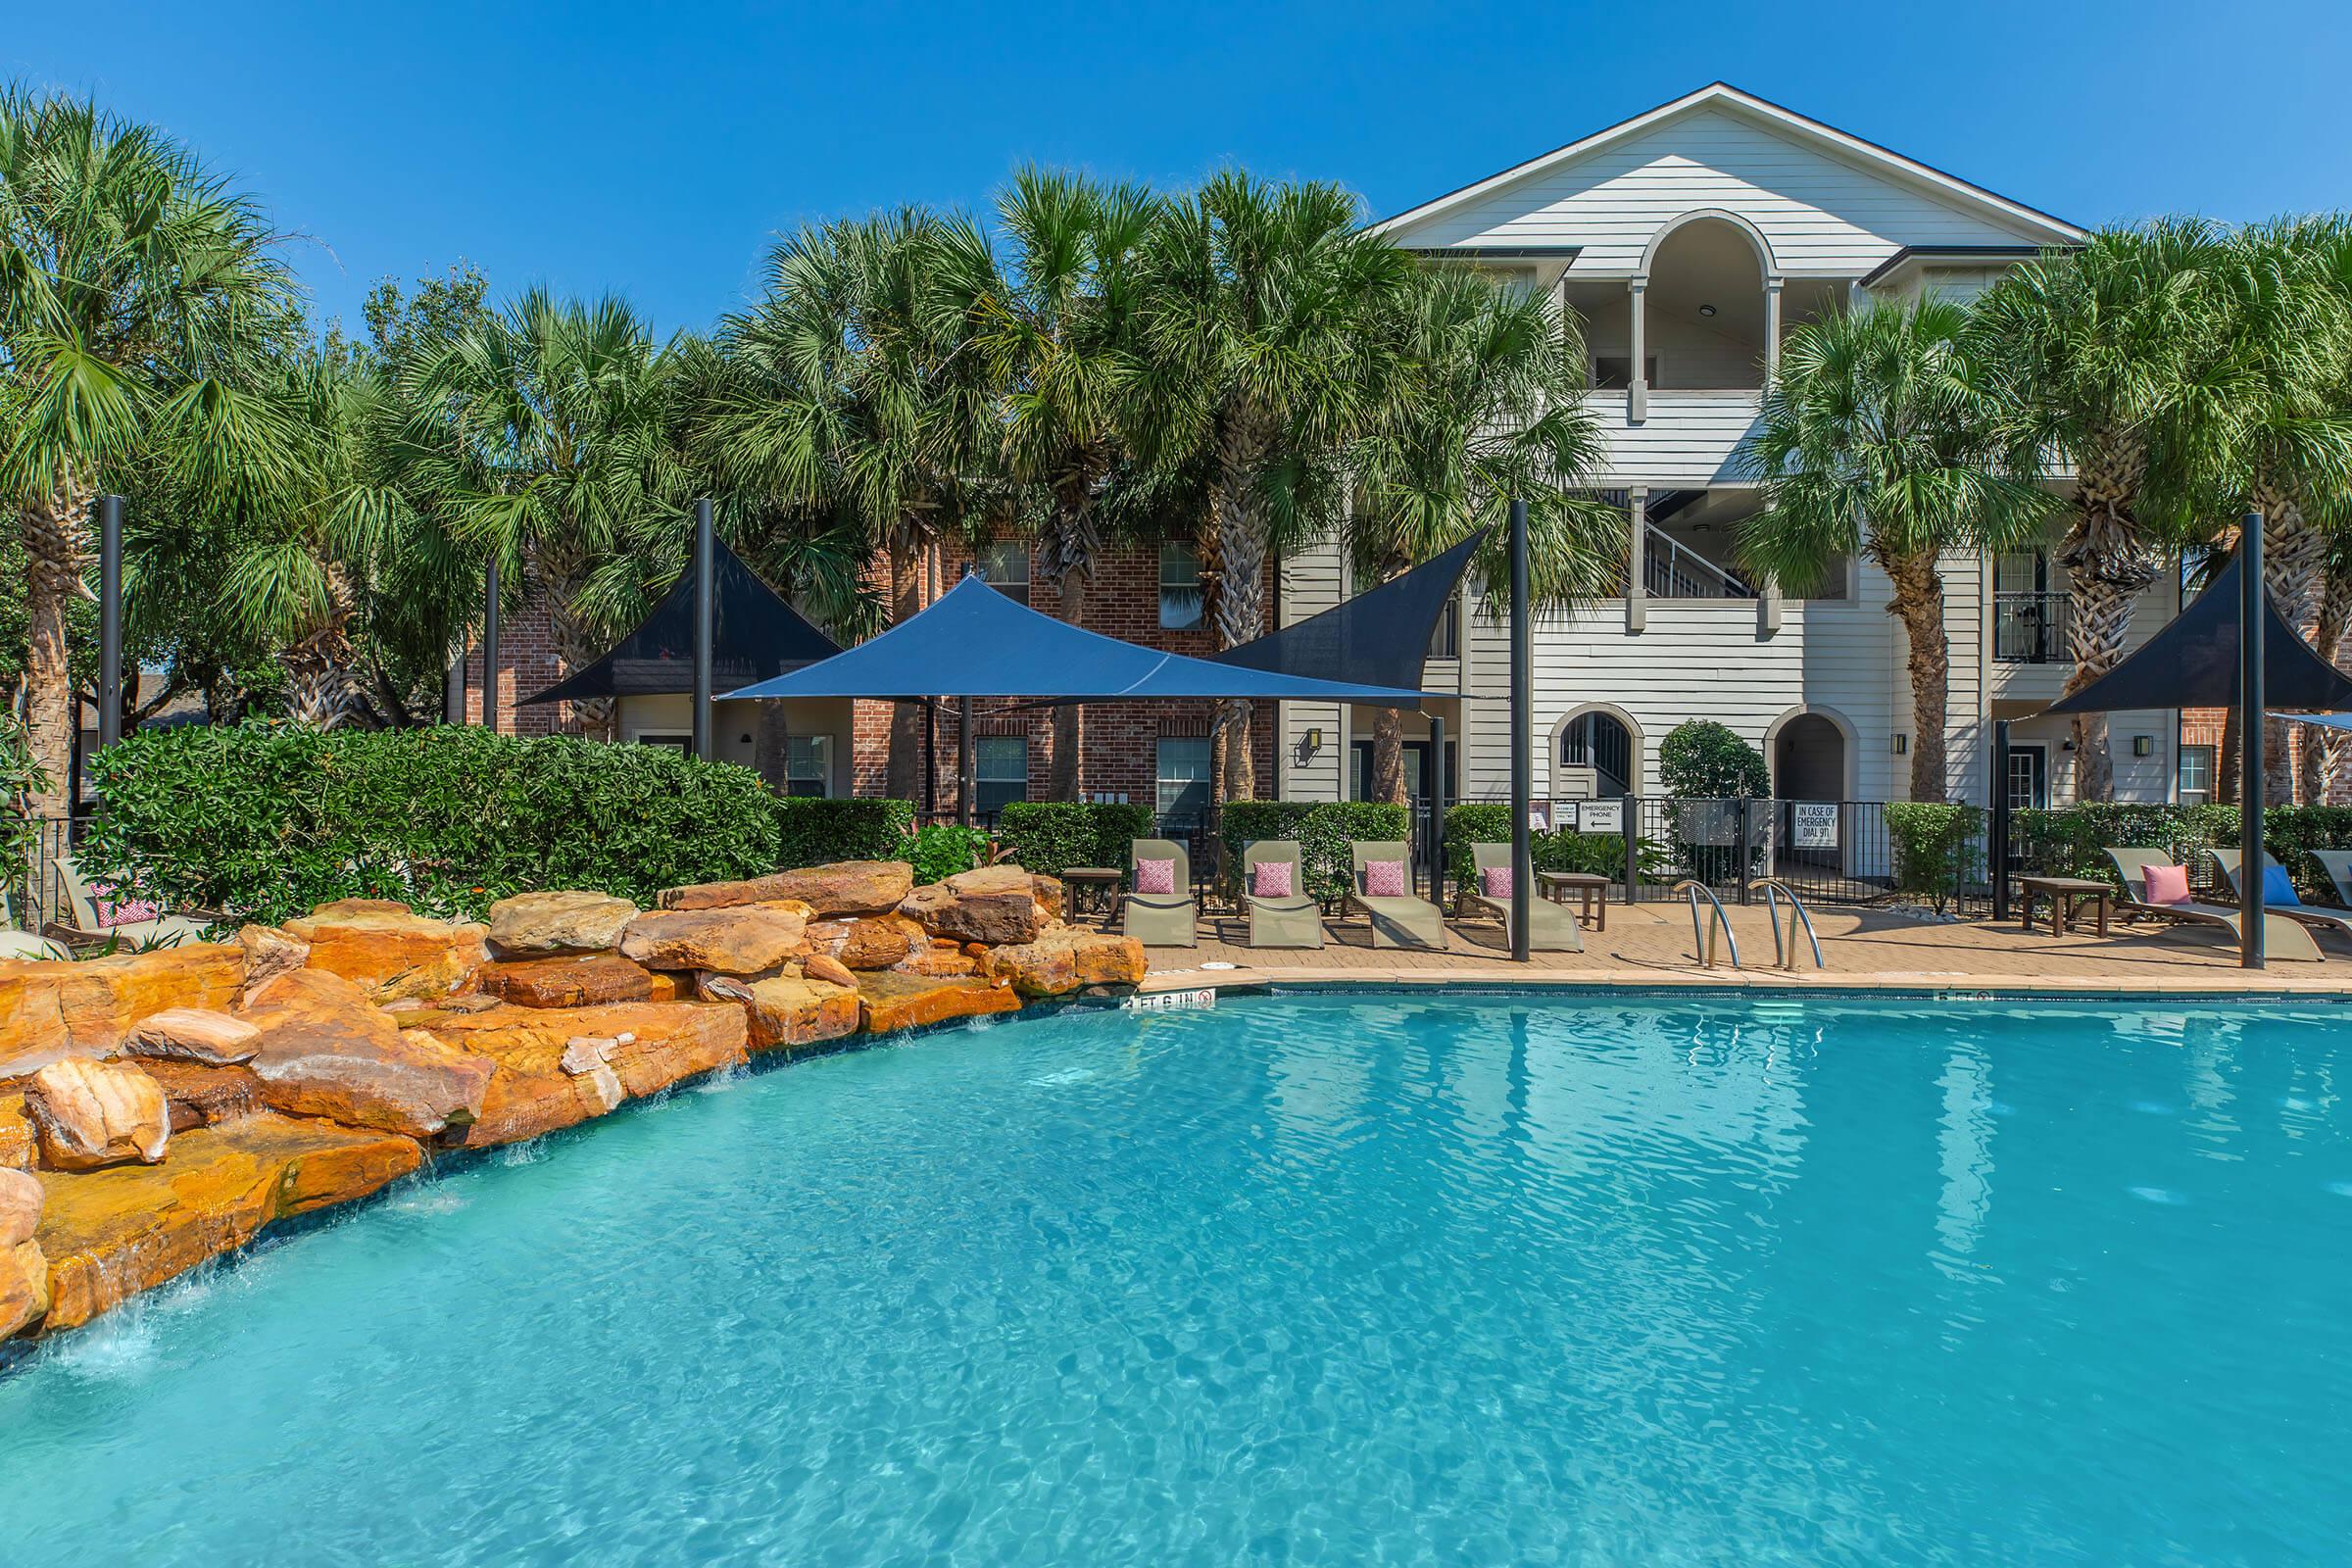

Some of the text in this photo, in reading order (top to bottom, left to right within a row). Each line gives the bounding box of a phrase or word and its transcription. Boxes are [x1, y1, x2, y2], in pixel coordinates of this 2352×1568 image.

[1799, 807, 1835, 816] IN CASE OF
[1797, 817, 1837, 827] EMERGENCY
[1803, 827, 1830, 837] DIAL 911
[1179, 993, 1193, 1004] IN
